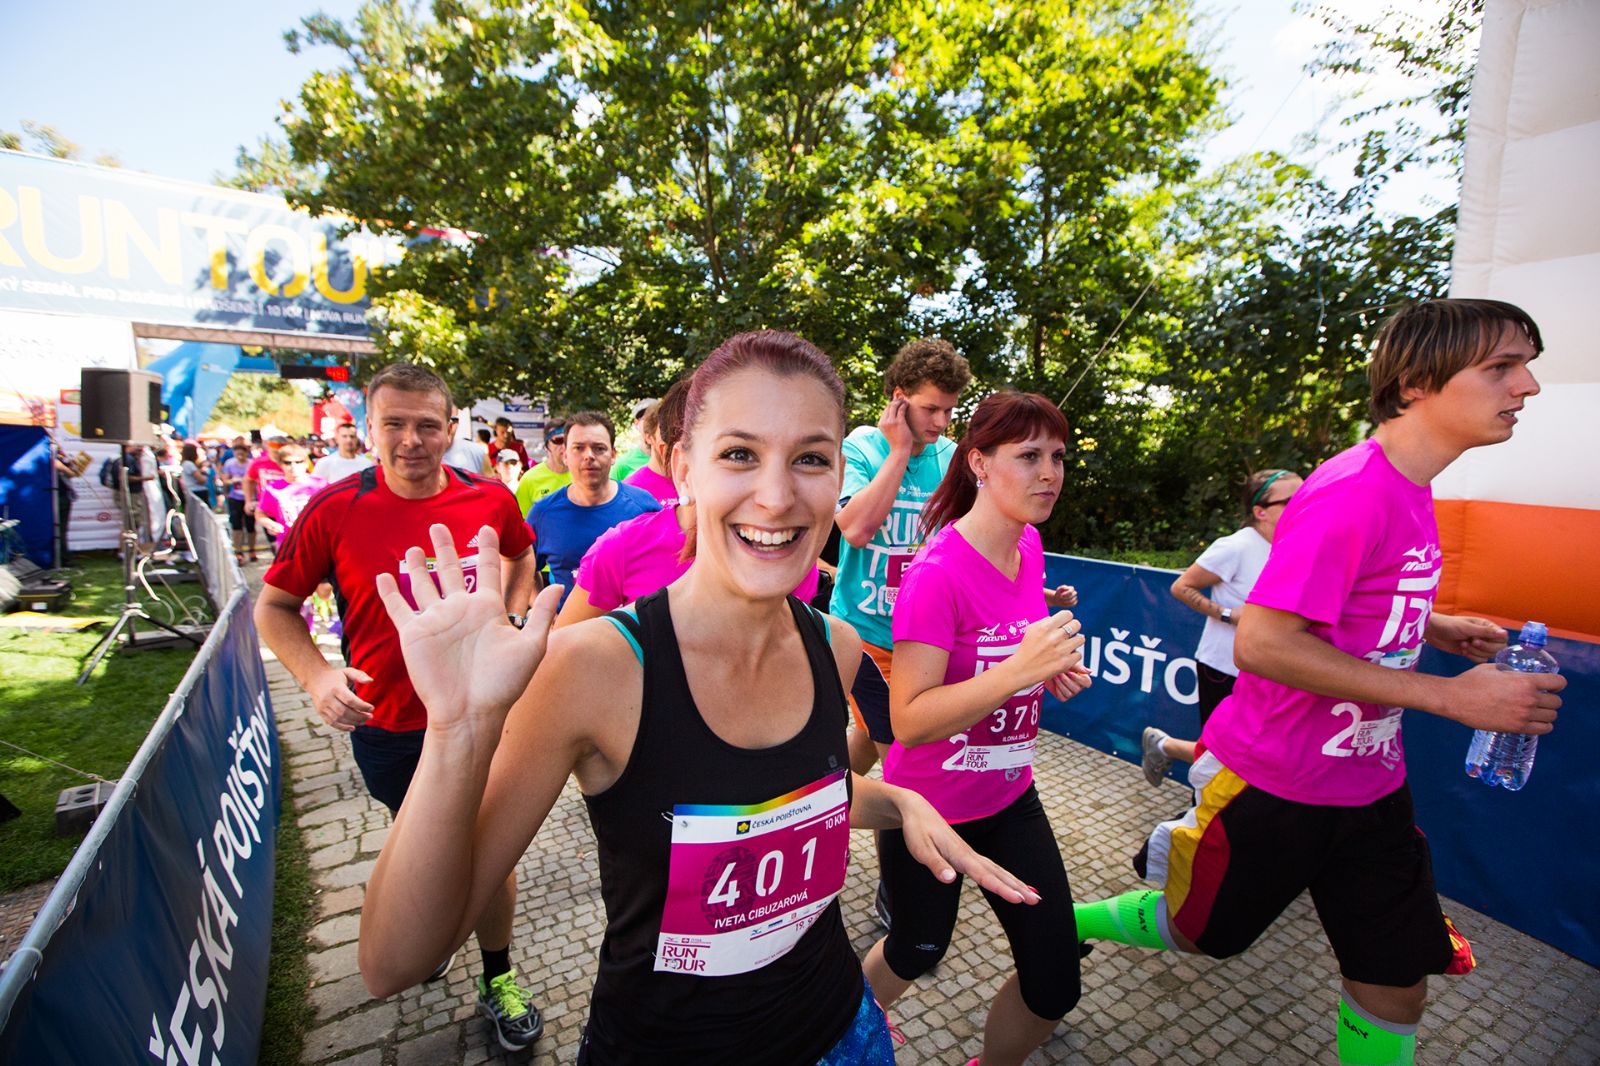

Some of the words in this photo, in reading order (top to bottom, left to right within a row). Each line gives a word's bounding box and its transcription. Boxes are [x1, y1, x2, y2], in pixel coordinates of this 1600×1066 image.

[0, 184, 386, 305] UNTOU
[990, 700, 1038, 733] 378
[966, 761, 988, 769] TOUR
[752, 816, 774, 829] ČESKÁ
[825, 820, 834, 830] 10
[834, 812, 846, 827] KM
[149, 838, 239, 1066] ESKÁ
[213, 690, 271, 898] POJIŠŤOV
[707, 837, 817, 908] 401
[714, 913, 746, 929] IVETA
[748, 888, 808, 921] CIBUZAROVÁ
[662, 945, 698, 959] RUN
[662, 956, 706, 972] TOUR
[1343, 1016, 1369, 1039] BAY
